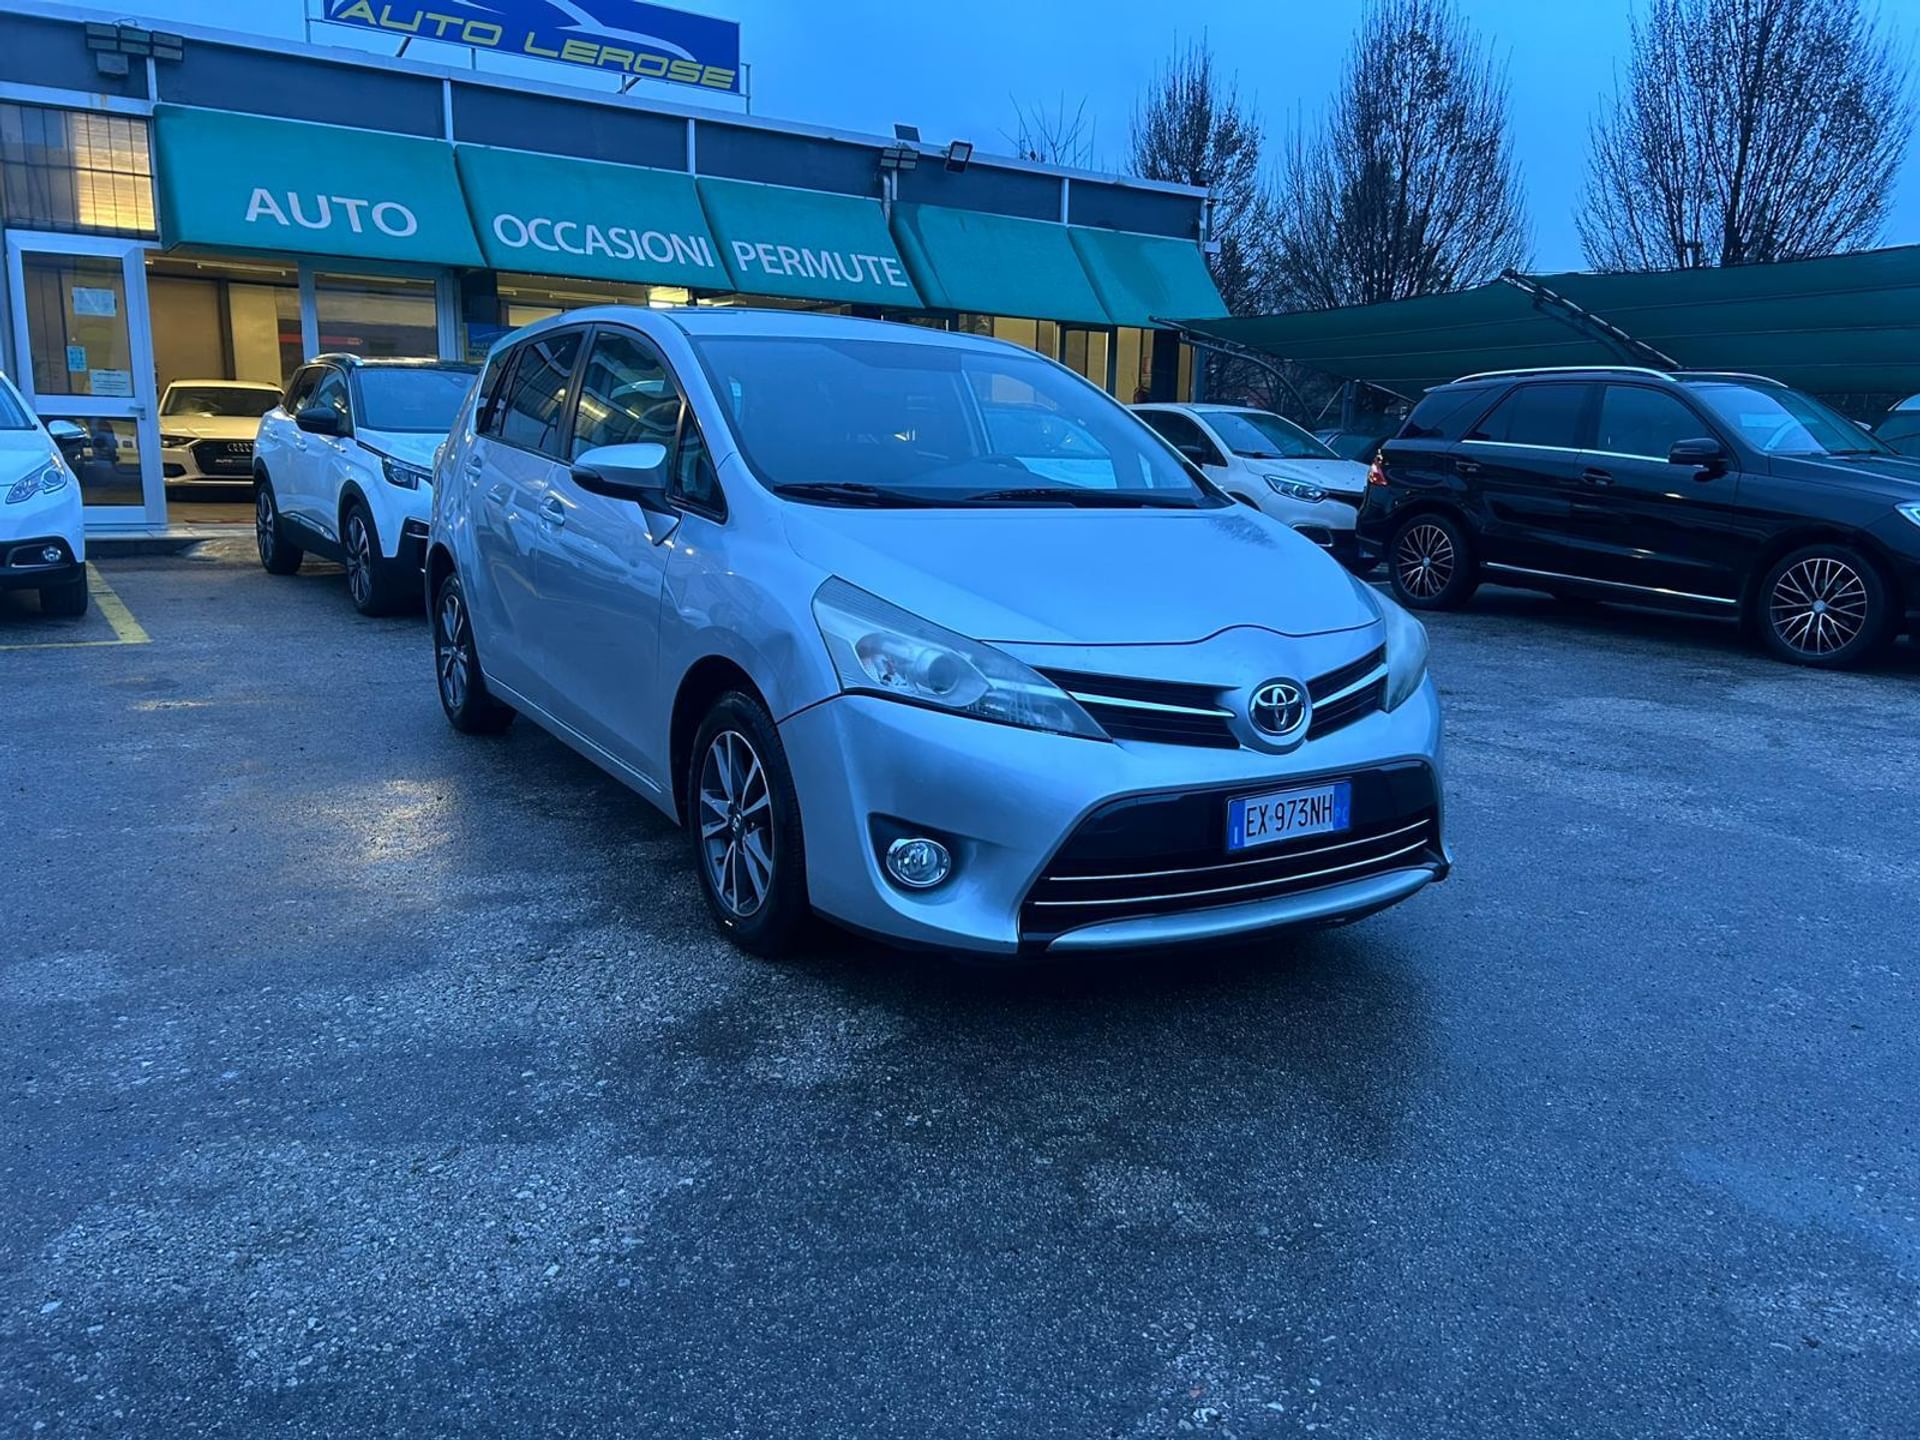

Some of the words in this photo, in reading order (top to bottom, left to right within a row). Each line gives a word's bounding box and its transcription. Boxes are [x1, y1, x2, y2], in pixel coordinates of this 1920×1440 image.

[337, 0, 502, 46] AUTO
[524, 31, 736, 90] LEROSE
[245, 188, 418, 237] AUTO
[493, 214, 715, 268] OCCASIONI
[732, 240, 908, 288] PERMUTE
